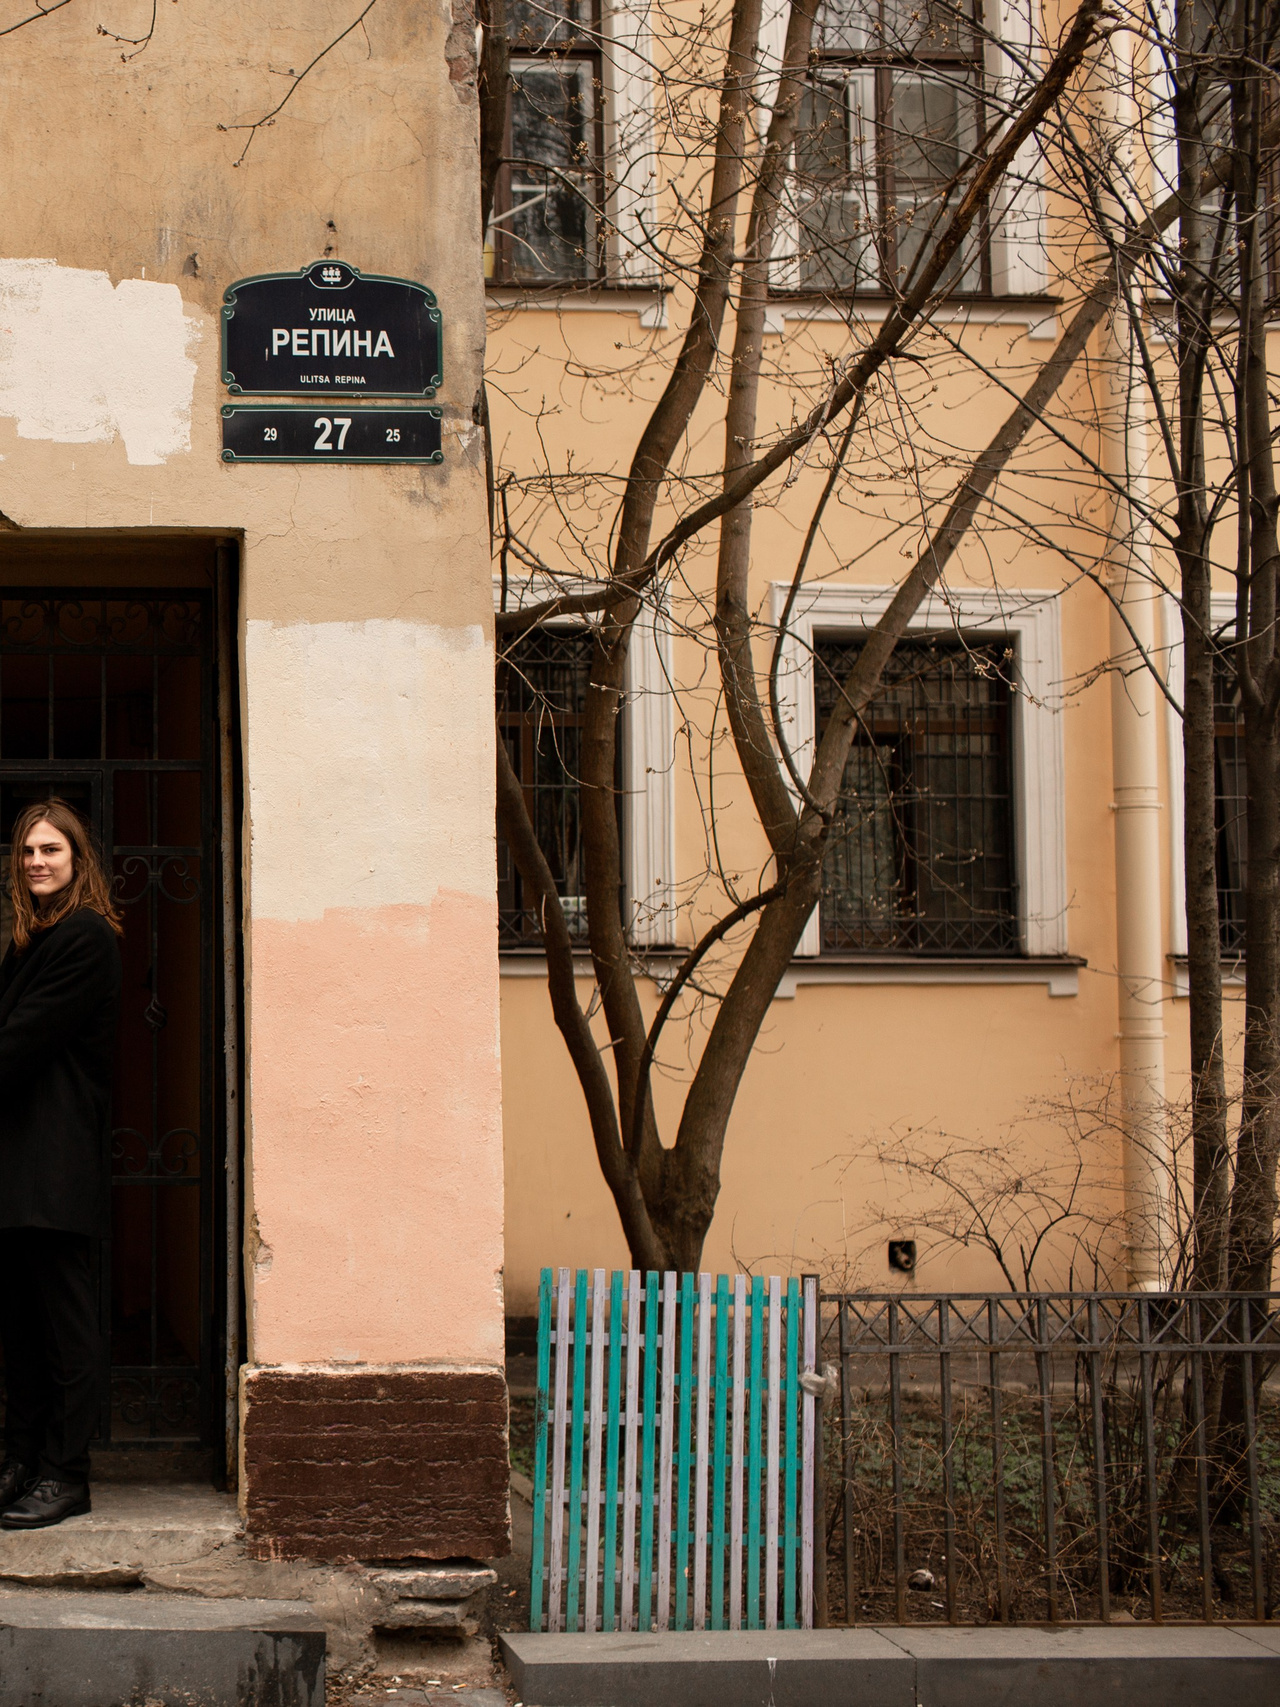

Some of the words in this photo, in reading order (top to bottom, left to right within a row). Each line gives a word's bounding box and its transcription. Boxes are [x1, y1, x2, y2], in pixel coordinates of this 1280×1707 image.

[309, 308, 356, 324] УЛИЦА
[272, 328, 395, 358] РЕПИНА
[300, 375, 330, 384] ULITSA
[335, 375, 366, 384] REPINA
[263, 427, 278, 442] 29
[313, 417, 352, 451] 27
[385, 428, 401, 443] 25
